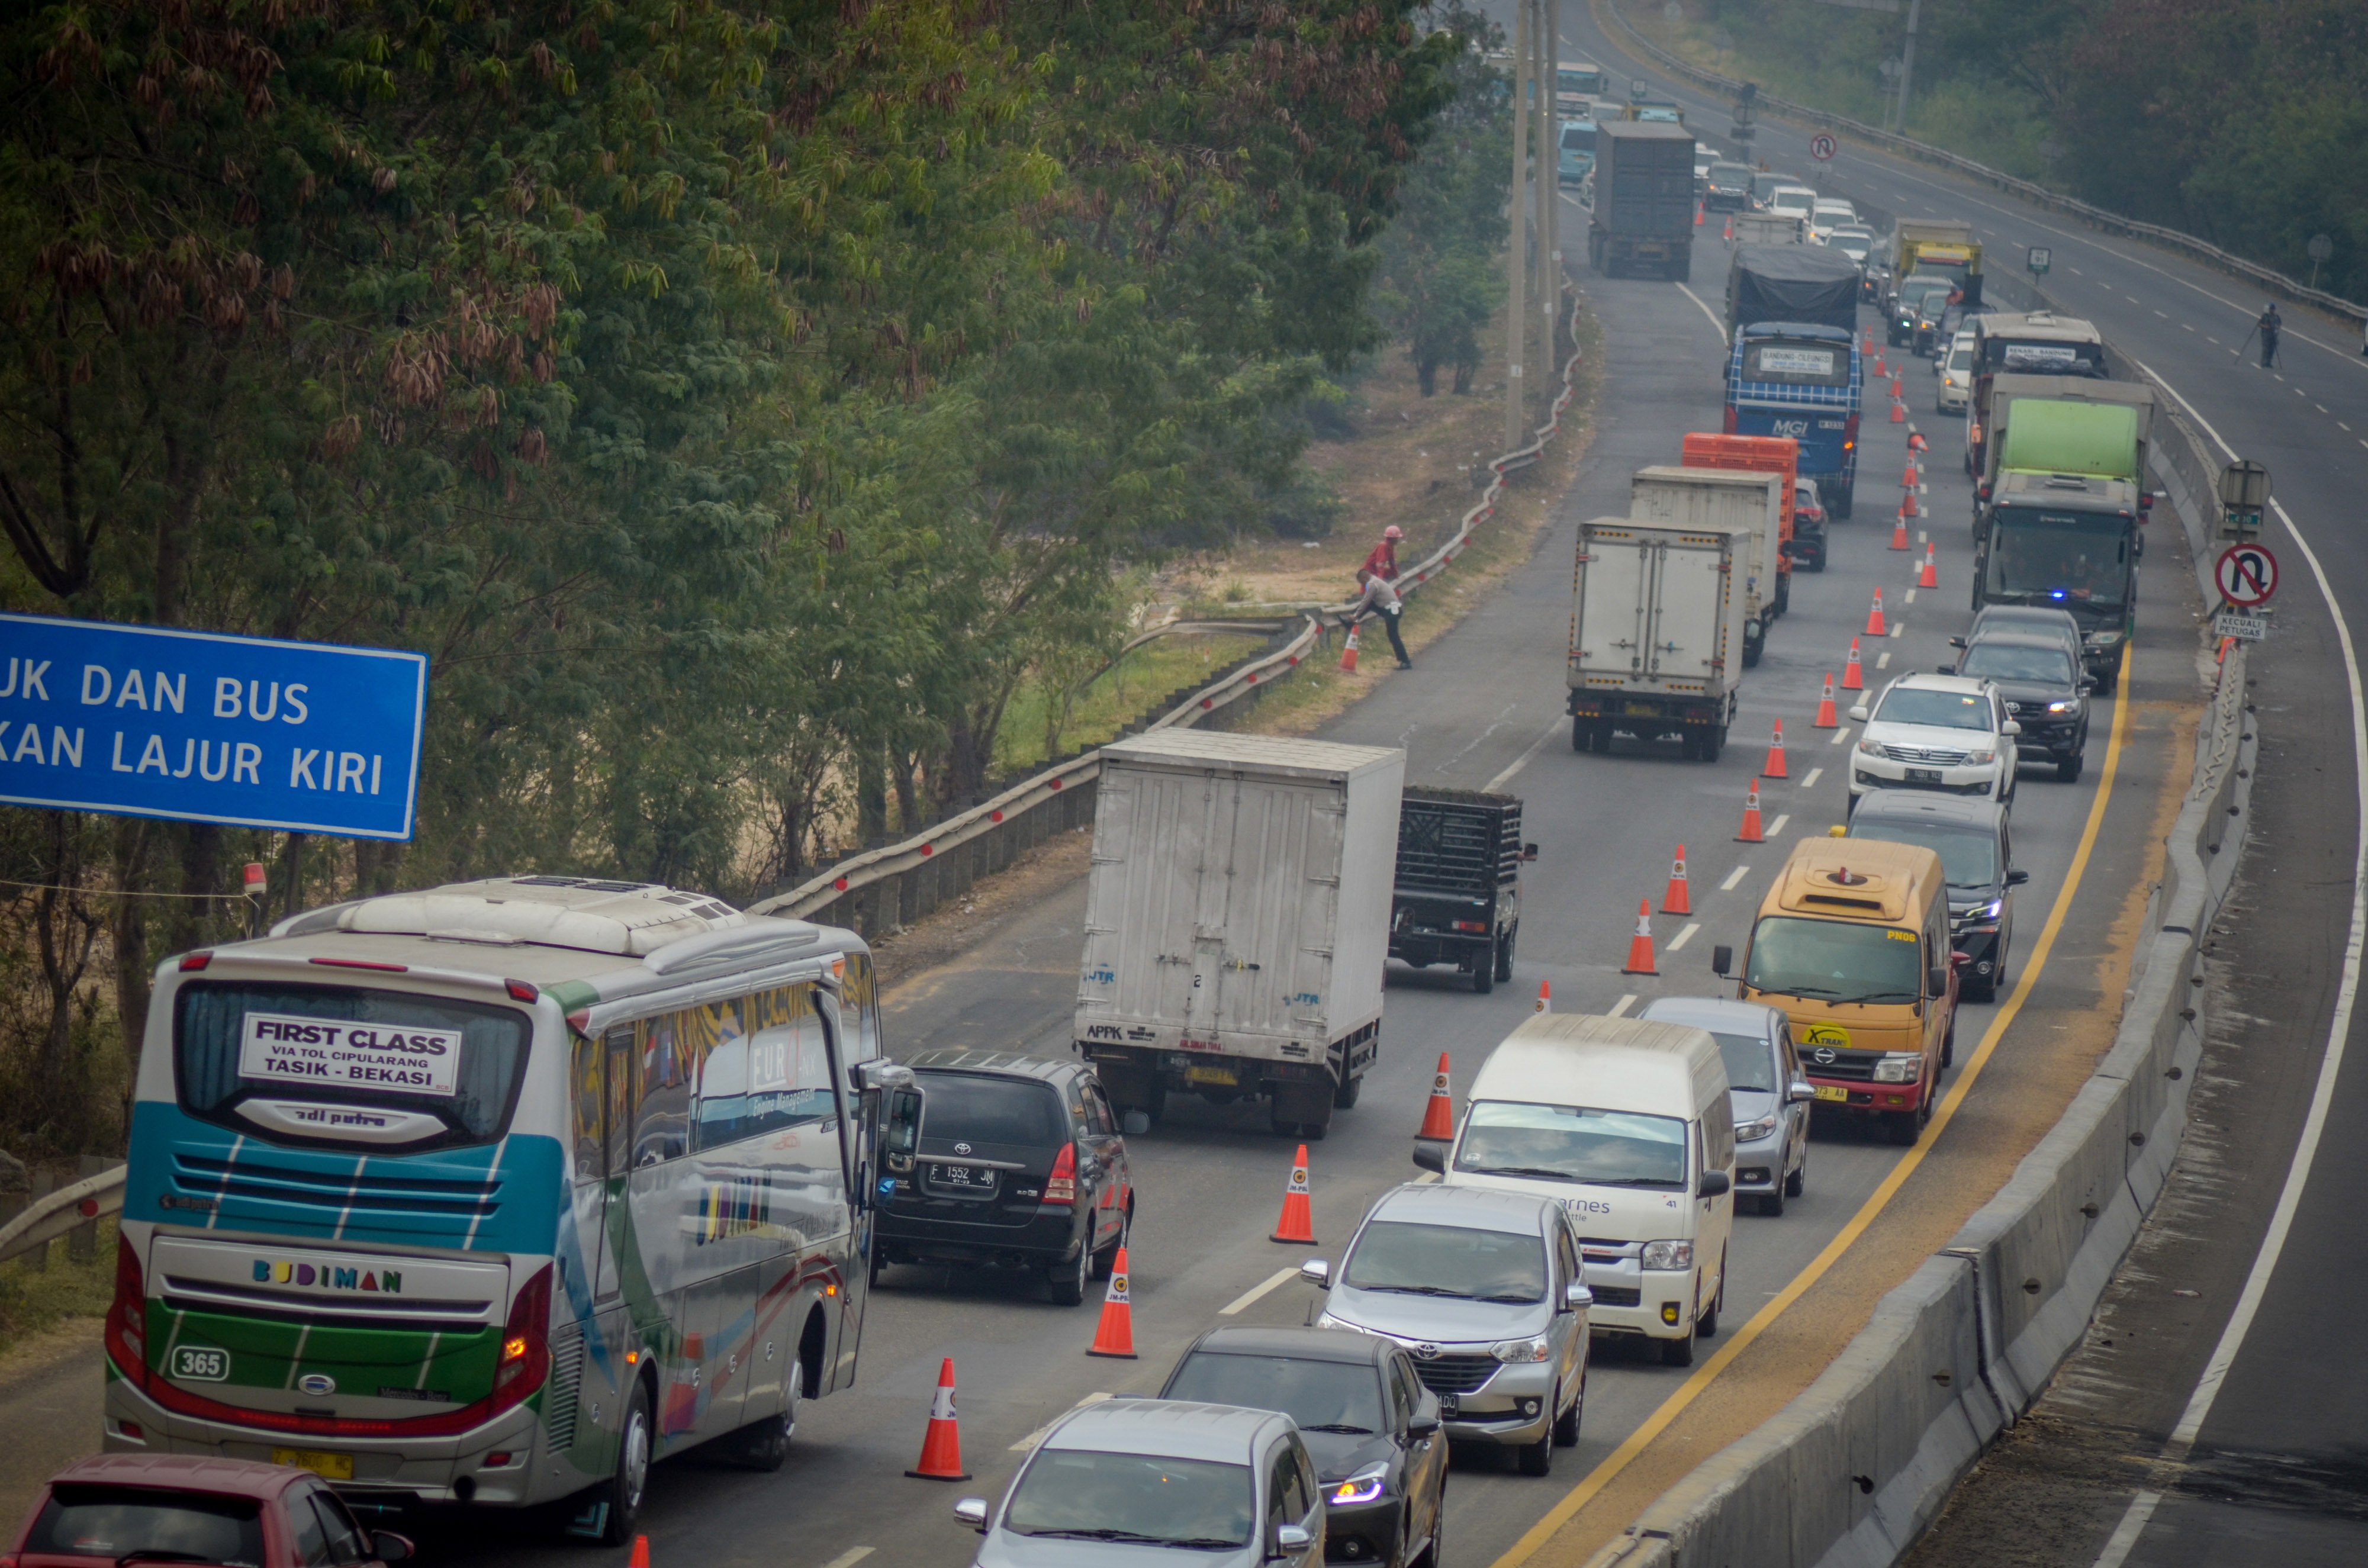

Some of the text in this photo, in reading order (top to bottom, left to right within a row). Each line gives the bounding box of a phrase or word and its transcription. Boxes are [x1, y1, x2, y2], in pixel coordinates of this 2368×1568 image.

[1772, 419, 1809, 435] MGI
[2222, 617, 2261, 627] KECUALI
[2219, 625, 2261, 637] PETUGAS
[81, 664, 186, 713] DAN
[213, 677, 309, 725] BUS
[112, 731, 262, 784] LAJUR
[289, 747, 382, 795] KIRI
[1887, 930, 1916, 942] PN06
[1089, 971, 1114, 983] JTR
[1193, 974, 1201, 987] 2
[1294, 993, 1319, 1005] JTR
[256, 1020, 447, 1056] FIRST CLASS
[1088, 1025, 1122, 1040] APPK
[271, 1045, 429, 1069] VIA TOL CIPULARANG
[264, 1058, 329, 1077] TASIK
[349, 1065, 432, 1086] BEKASI
[753, 1088, 815, 1120] Engine Management
[931, 1164, 993, 1183] F 1552 JM
[1561, 1198, 1610, 1213] arnes
[1666, 1200, 1677, 1208] 41
[252, 1260, 403, 1293] BUDIMAN
[181, 1351, 221, 1375] 365
[381, 1387, 419, 1400] Mercedes
[427, 1391, 448, 1403] Benz
[295, 1453, 323, 1468] 7600
[335, 1457, 350, 1471] HC
